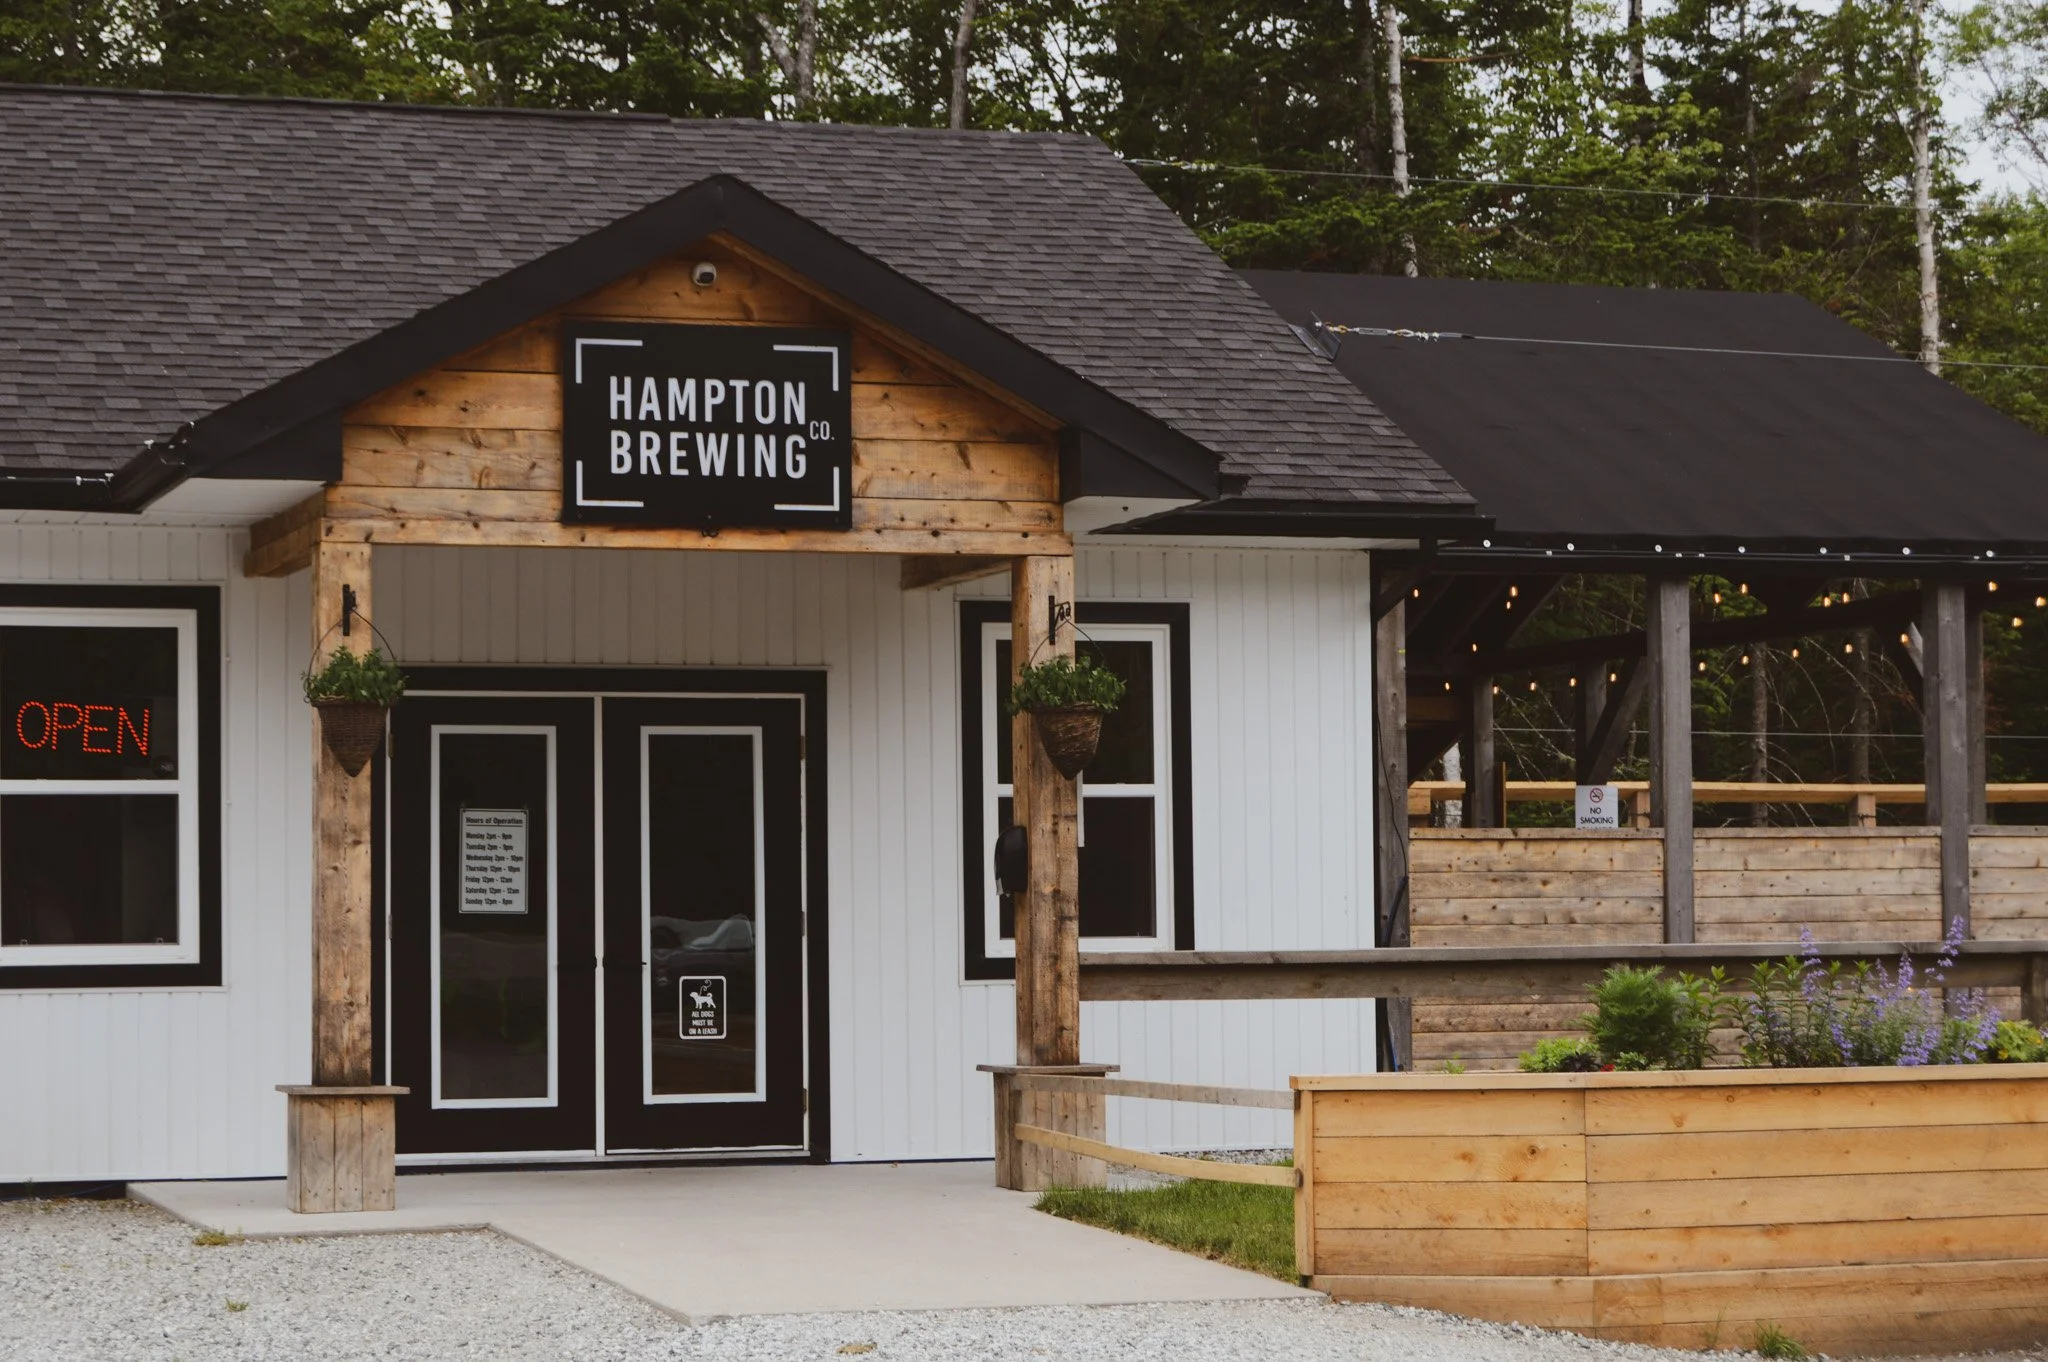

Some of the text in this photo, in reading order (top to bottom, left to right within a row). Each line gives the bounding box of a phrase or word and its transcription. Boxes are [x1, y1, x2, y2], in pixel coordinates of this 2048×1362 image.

[609, 375, 806, 426] HAMPTON
[809, 420, 835, 441] CO.
[610, 429, 807, 479] BREWING
[16, 701, 149, 756] OPEN
[493, 817, 523, 826] Operation
[466, 832, 485, 840] Monday
[466, 854, 493, 862] Wednesday
[465, 887, 487, 895] Saturday
